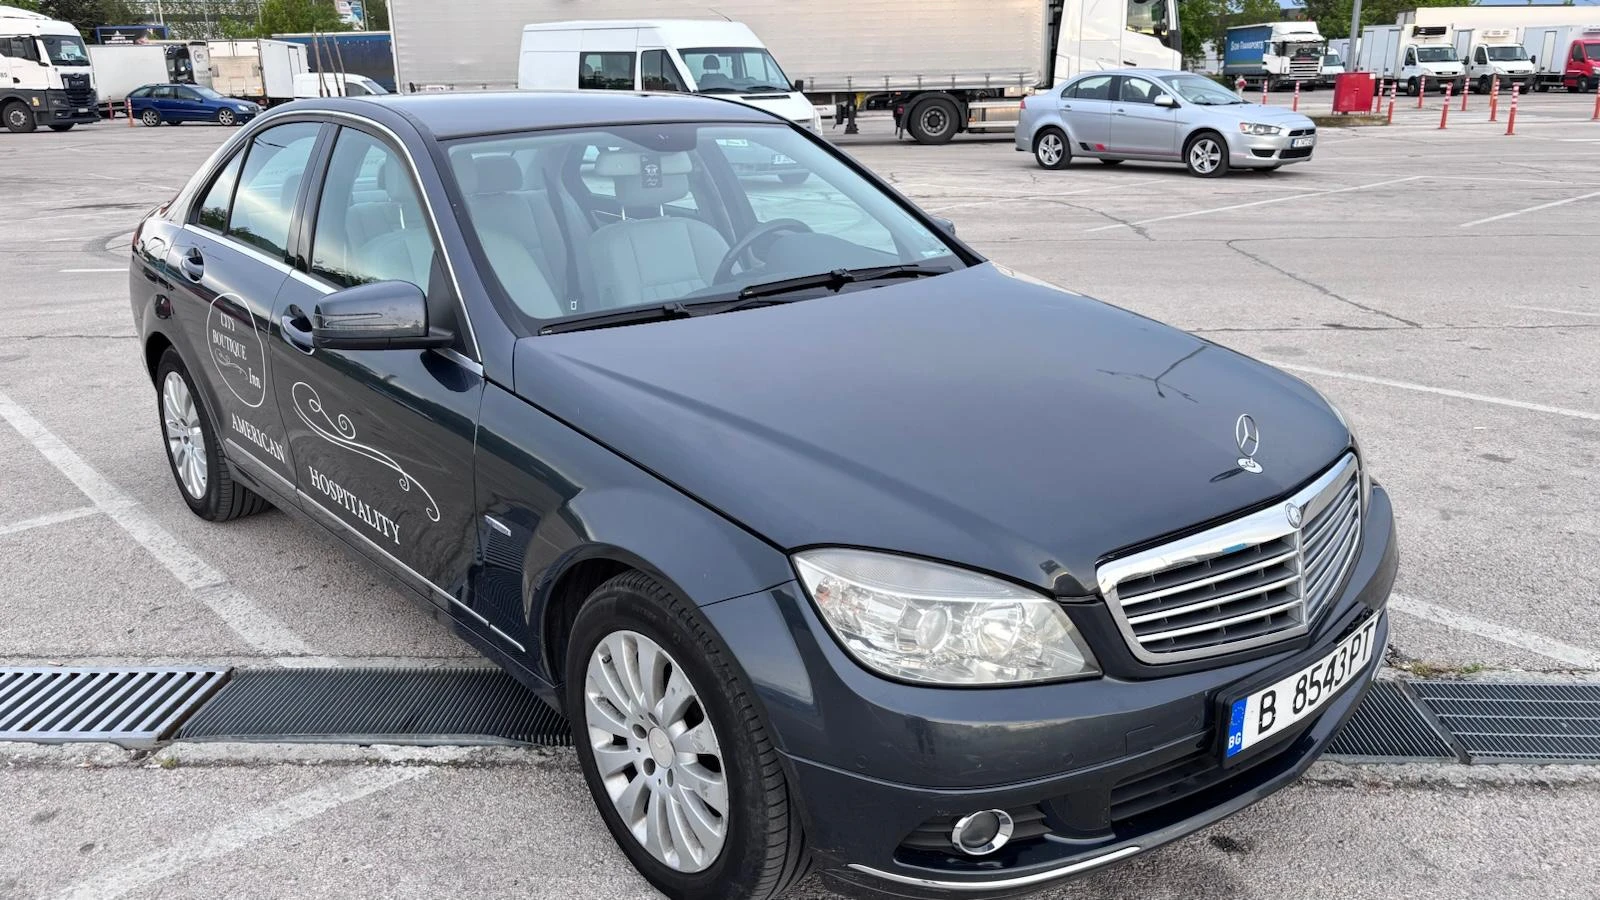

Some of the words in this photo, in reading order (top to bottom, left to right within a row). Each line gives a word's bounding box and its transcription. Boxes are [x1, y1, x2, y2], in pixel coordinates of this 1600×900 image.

[220, 312, 235, 332] CITY
[212, 329, 247, 360] BOUTIQUE
[248, 367, 261, 389] Inn
[231, 413, 286, 464] AMERICAN
[308, 466, 401, 545] HOSPITALITY
[1229, 733, 1242, 749] BG
[1258, 690, 1276, 735] B
